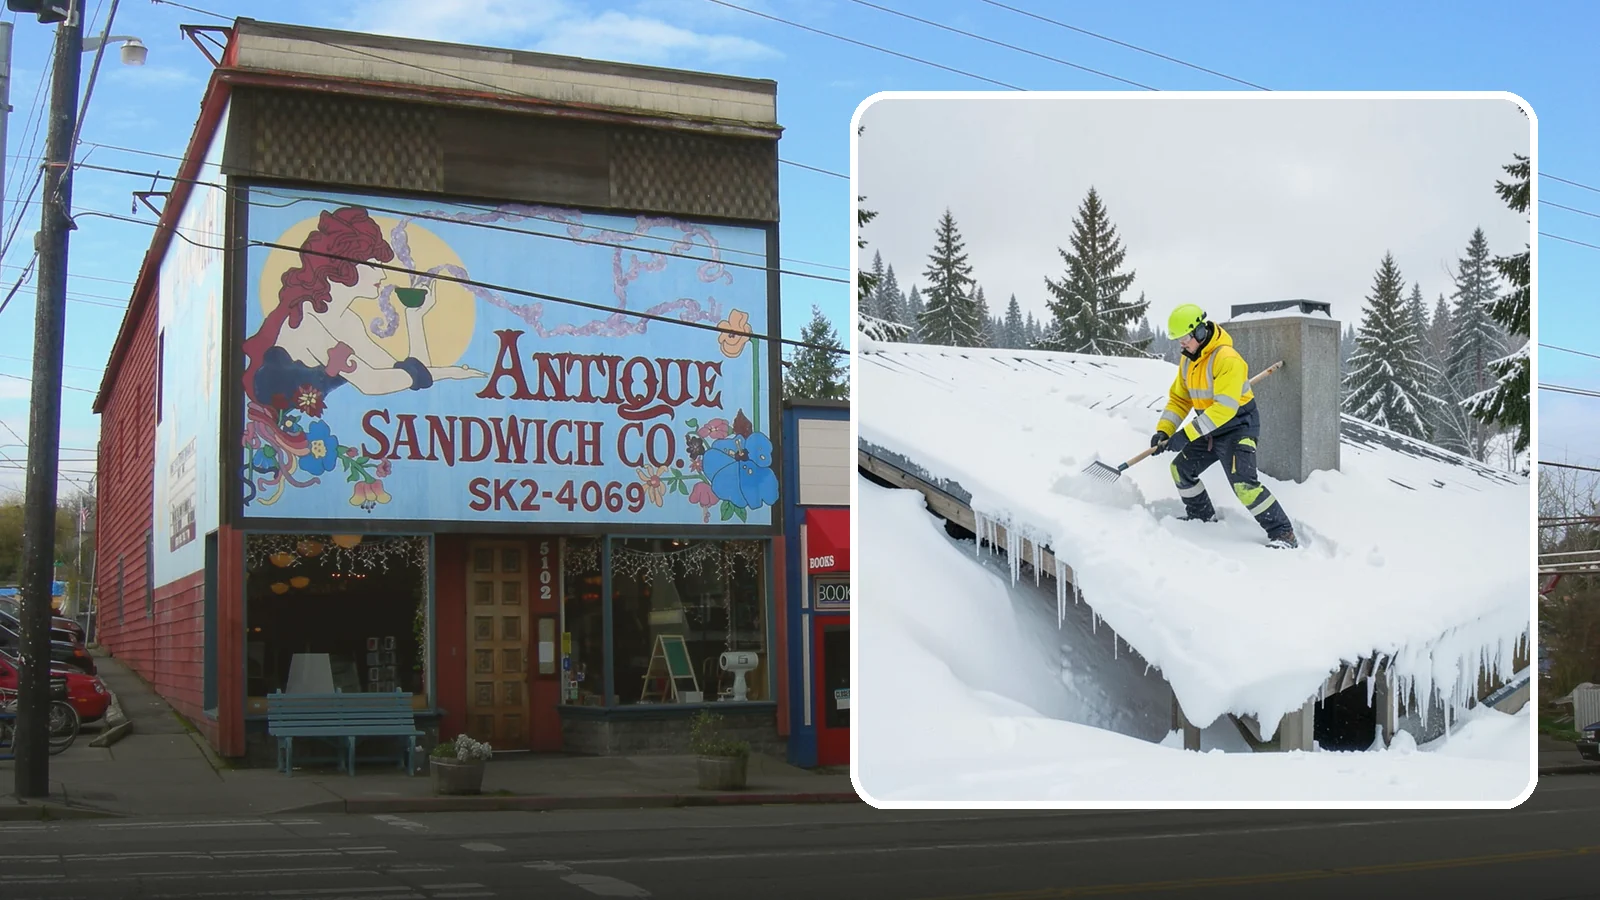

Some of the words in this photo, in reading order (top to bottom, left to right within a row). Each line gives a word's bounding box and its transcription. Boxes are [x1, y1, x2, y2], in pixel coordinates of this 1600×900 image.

[475, 329, 724, 421] ANTIQUE
[361, 408, 604, 467] SANDWICH
[617, 421, 685, 469] CO.
[468, 476, 646, 513] SK2-4069
[539, 541, 551, 600] 5102
[809, 555, 835, 569] BOOKS
